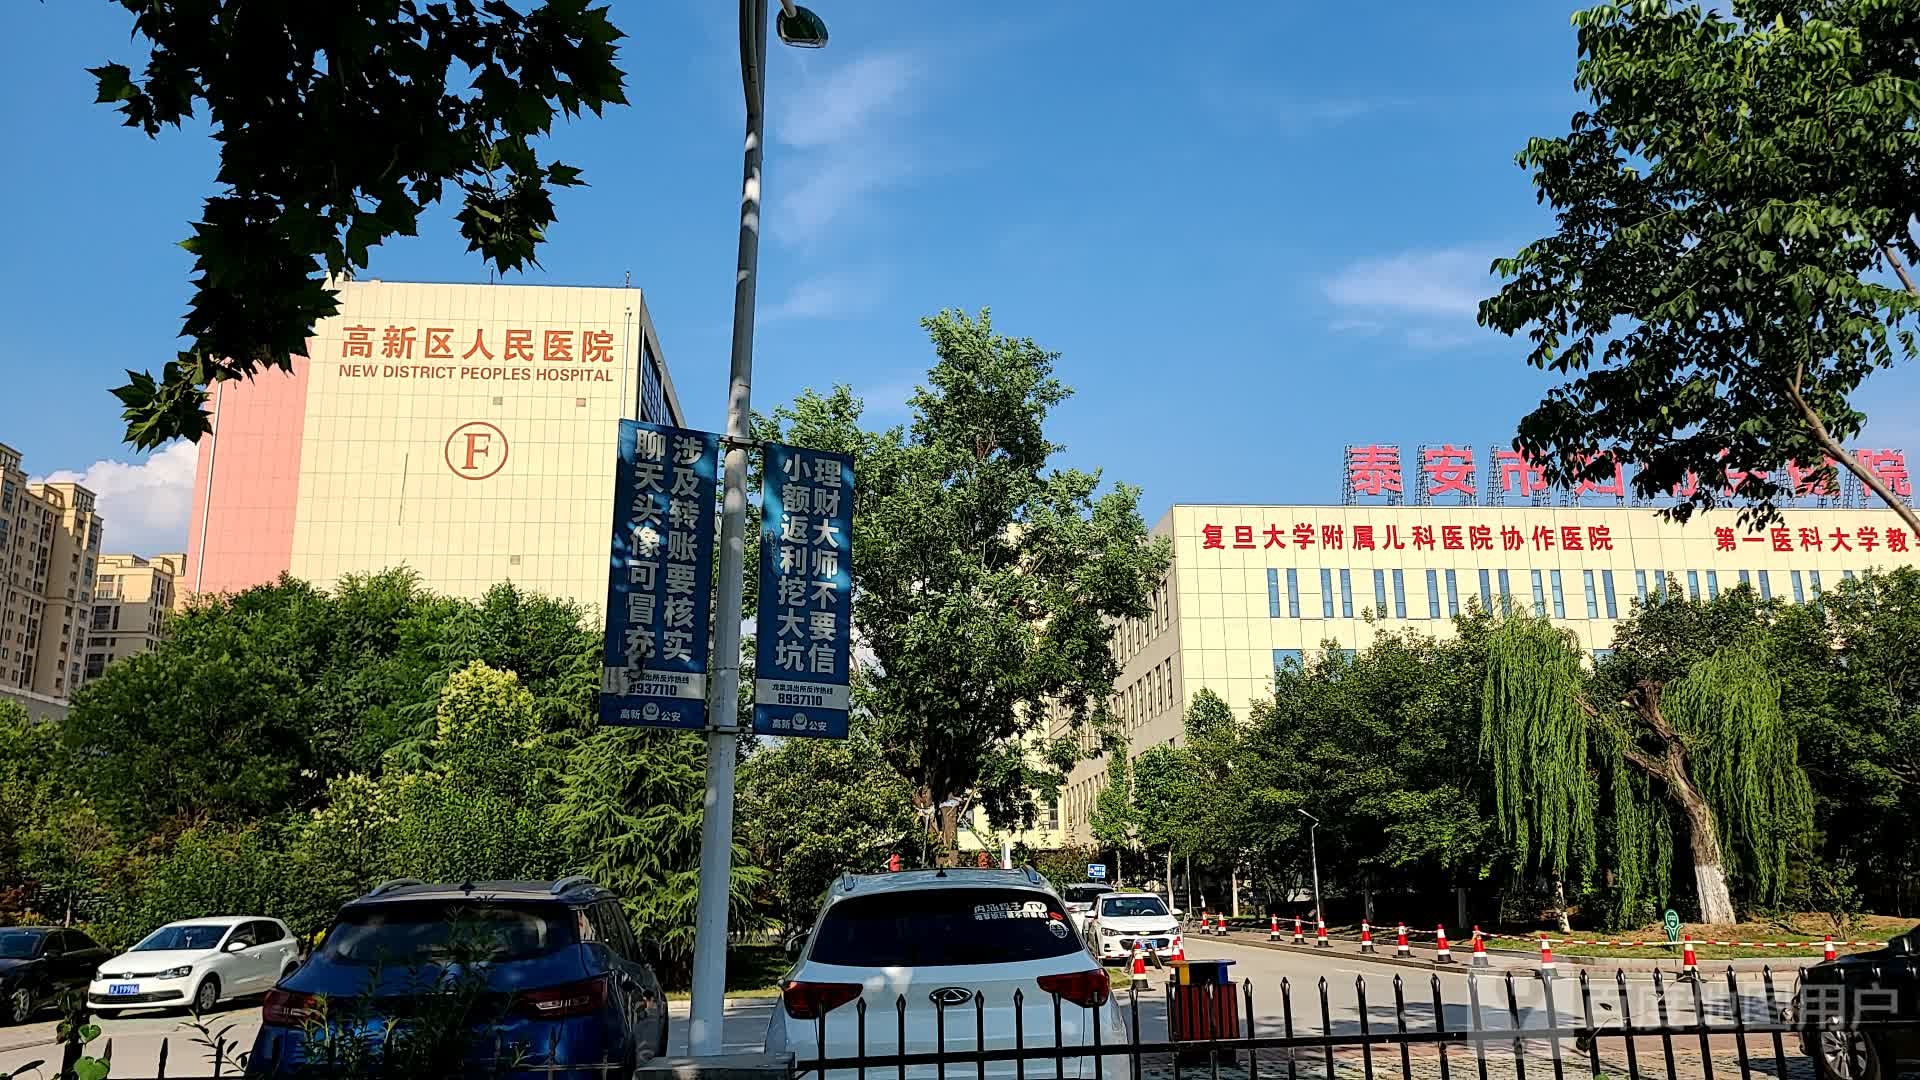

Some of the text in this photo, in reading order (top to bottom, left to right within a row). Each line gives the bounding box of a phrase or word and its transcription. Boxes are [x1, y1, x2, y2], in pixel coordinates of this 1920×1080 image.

[342, 325, 614, 362] 高新区人民医院
[339, 364, 614, 382] NEW DISTRICT PEOPLES HOSPITAL
[462, 433, 491, 469] F
[624, 429, 666, 660] 聊天头像可冒充
[663, 435, 703, 663] 涉及转账要核实
[1202, 523, 1614, 551] 复旦大学附属儿科医院协作医院
[1713, 526, 1920, 552] 第一医科大学教
[775, 453, 812, 672] 小额返利挖大坑
[808, 457, 842, 675] 理财大师不要信
[620, 708, 681, 722] 高新 公安
[778, 693, 823, 706] 8937110
[772, 719, 827, 731] 高新 公安
